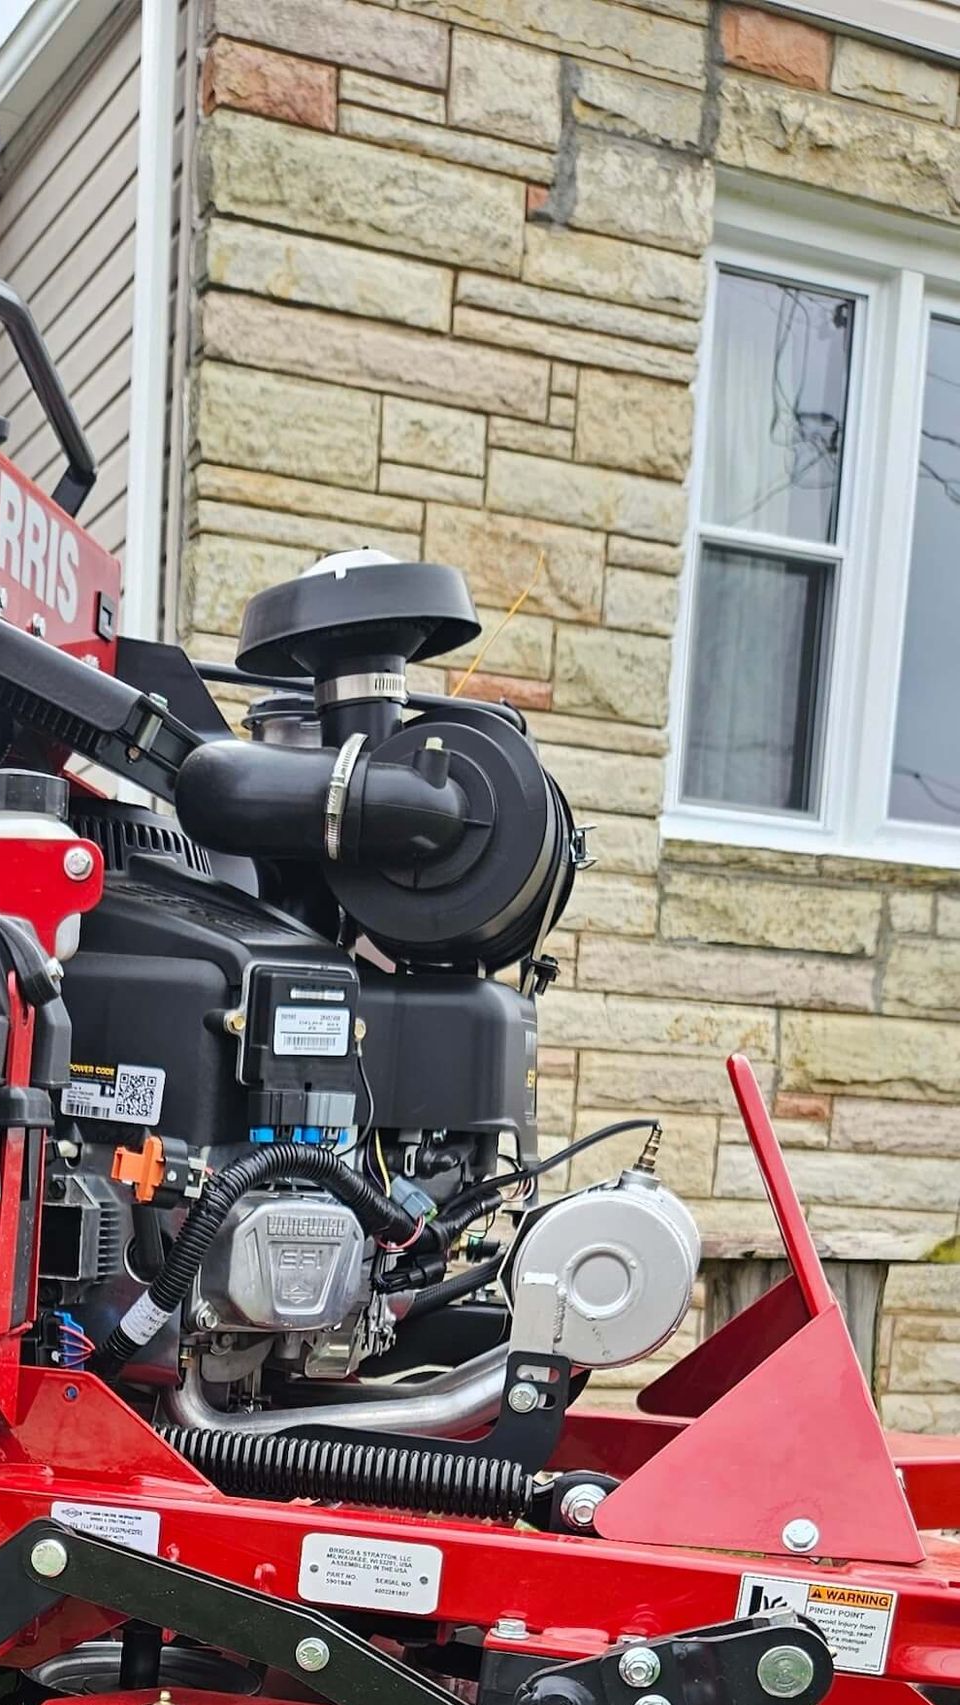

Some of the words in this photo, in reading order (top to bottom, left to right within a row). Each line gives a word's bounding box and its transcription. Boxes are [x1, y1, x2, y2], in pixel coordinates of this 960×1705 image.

[95, 1066, 115, 1076] CODE
[267, 1215, 345, 1238] VANGUARD
[279, 1249, 323, 1270] EFI
[329, 1547, 355, 1556] BRIGGS
[331, 1560, 372, 1570] ASSEMBLED
[381, 1565, 393, 1573] THE
[326, 1571, 344, 1579] PART
[376, 1578, 399, 1587] SERIAL
[826, 1589, 889, 1607] WARNING
[809, 1606, 836, 1616] PINCH
[839, 1608, 865, 1620] POINT
[817, 1618, 837, 1626] avoid
[838, 1619, 858, 1630] injury
[860, 1622, 876, 1630] from
[856, 1630, 873, 1638] read
[841, 1638, 867, 1646] manual
